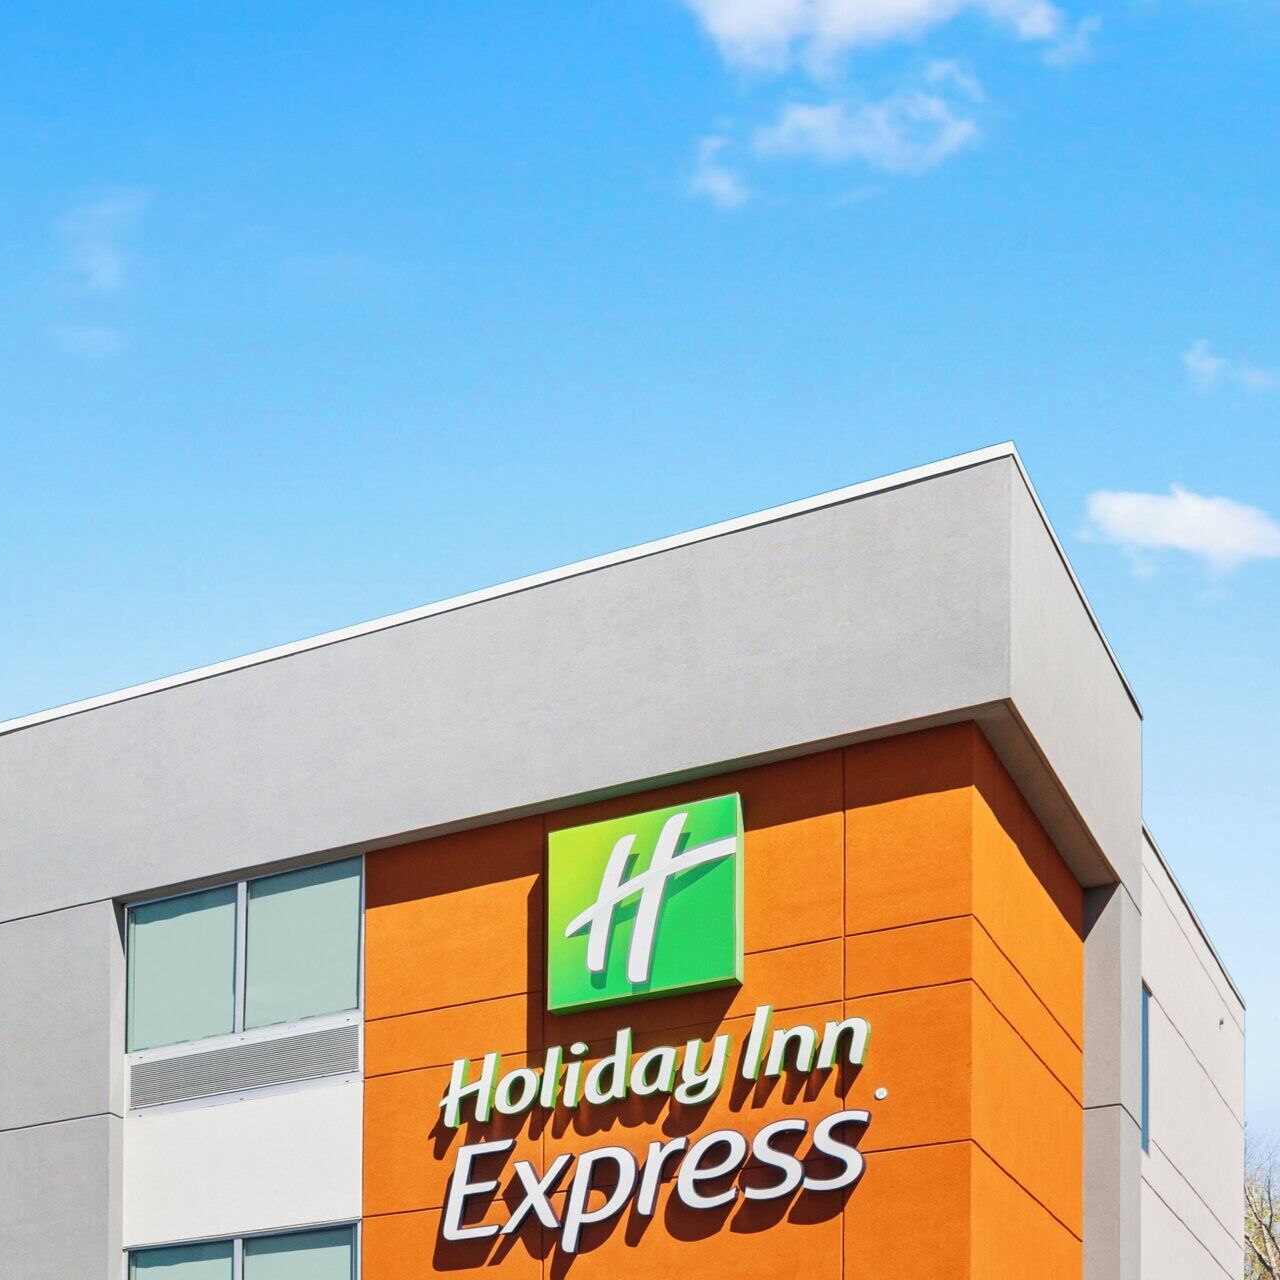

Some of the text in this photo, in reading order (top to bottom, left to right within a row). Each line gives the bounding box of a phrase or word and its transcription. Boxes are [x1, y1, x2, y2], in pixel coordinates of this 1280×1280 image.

[439, 1004, 872, 1128] Holiday Inn
[442, 1109, 872, 1254] Express
